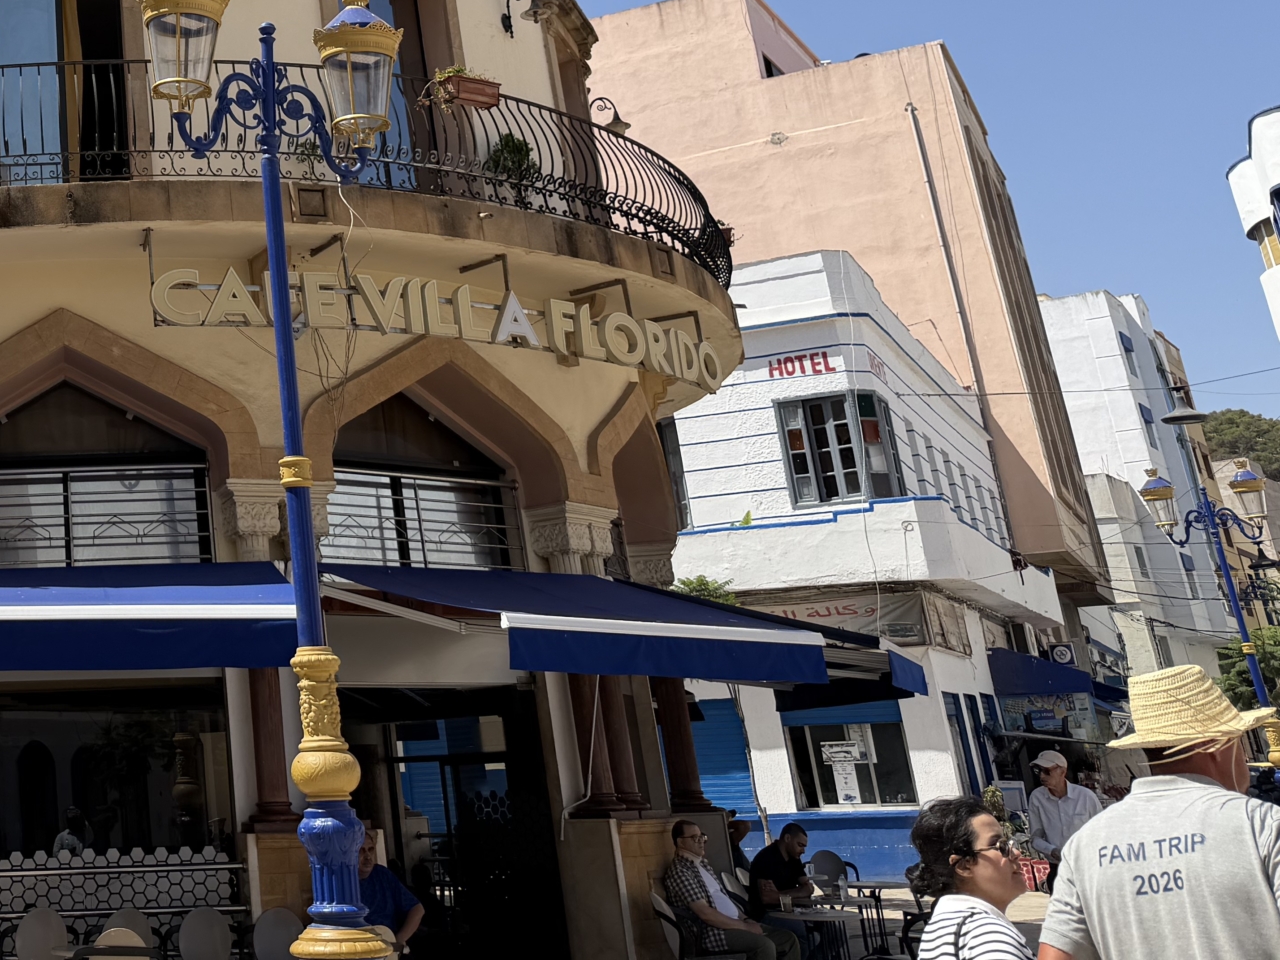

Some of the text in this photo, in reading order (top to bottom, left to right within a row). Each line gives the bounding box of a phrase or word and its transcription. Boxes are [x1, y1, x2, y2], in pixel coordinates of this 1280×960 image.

[351, 274, 540, 346] VILLA
[544, 297, 721, 392] FLORIDO
[768, 351, 837, 379] HOTEL
[806, 603, 879, 619] وكالة
[1098, 833, 1207, 867] FAM TRIP
[1132, 869, 1184, 896] 2026
